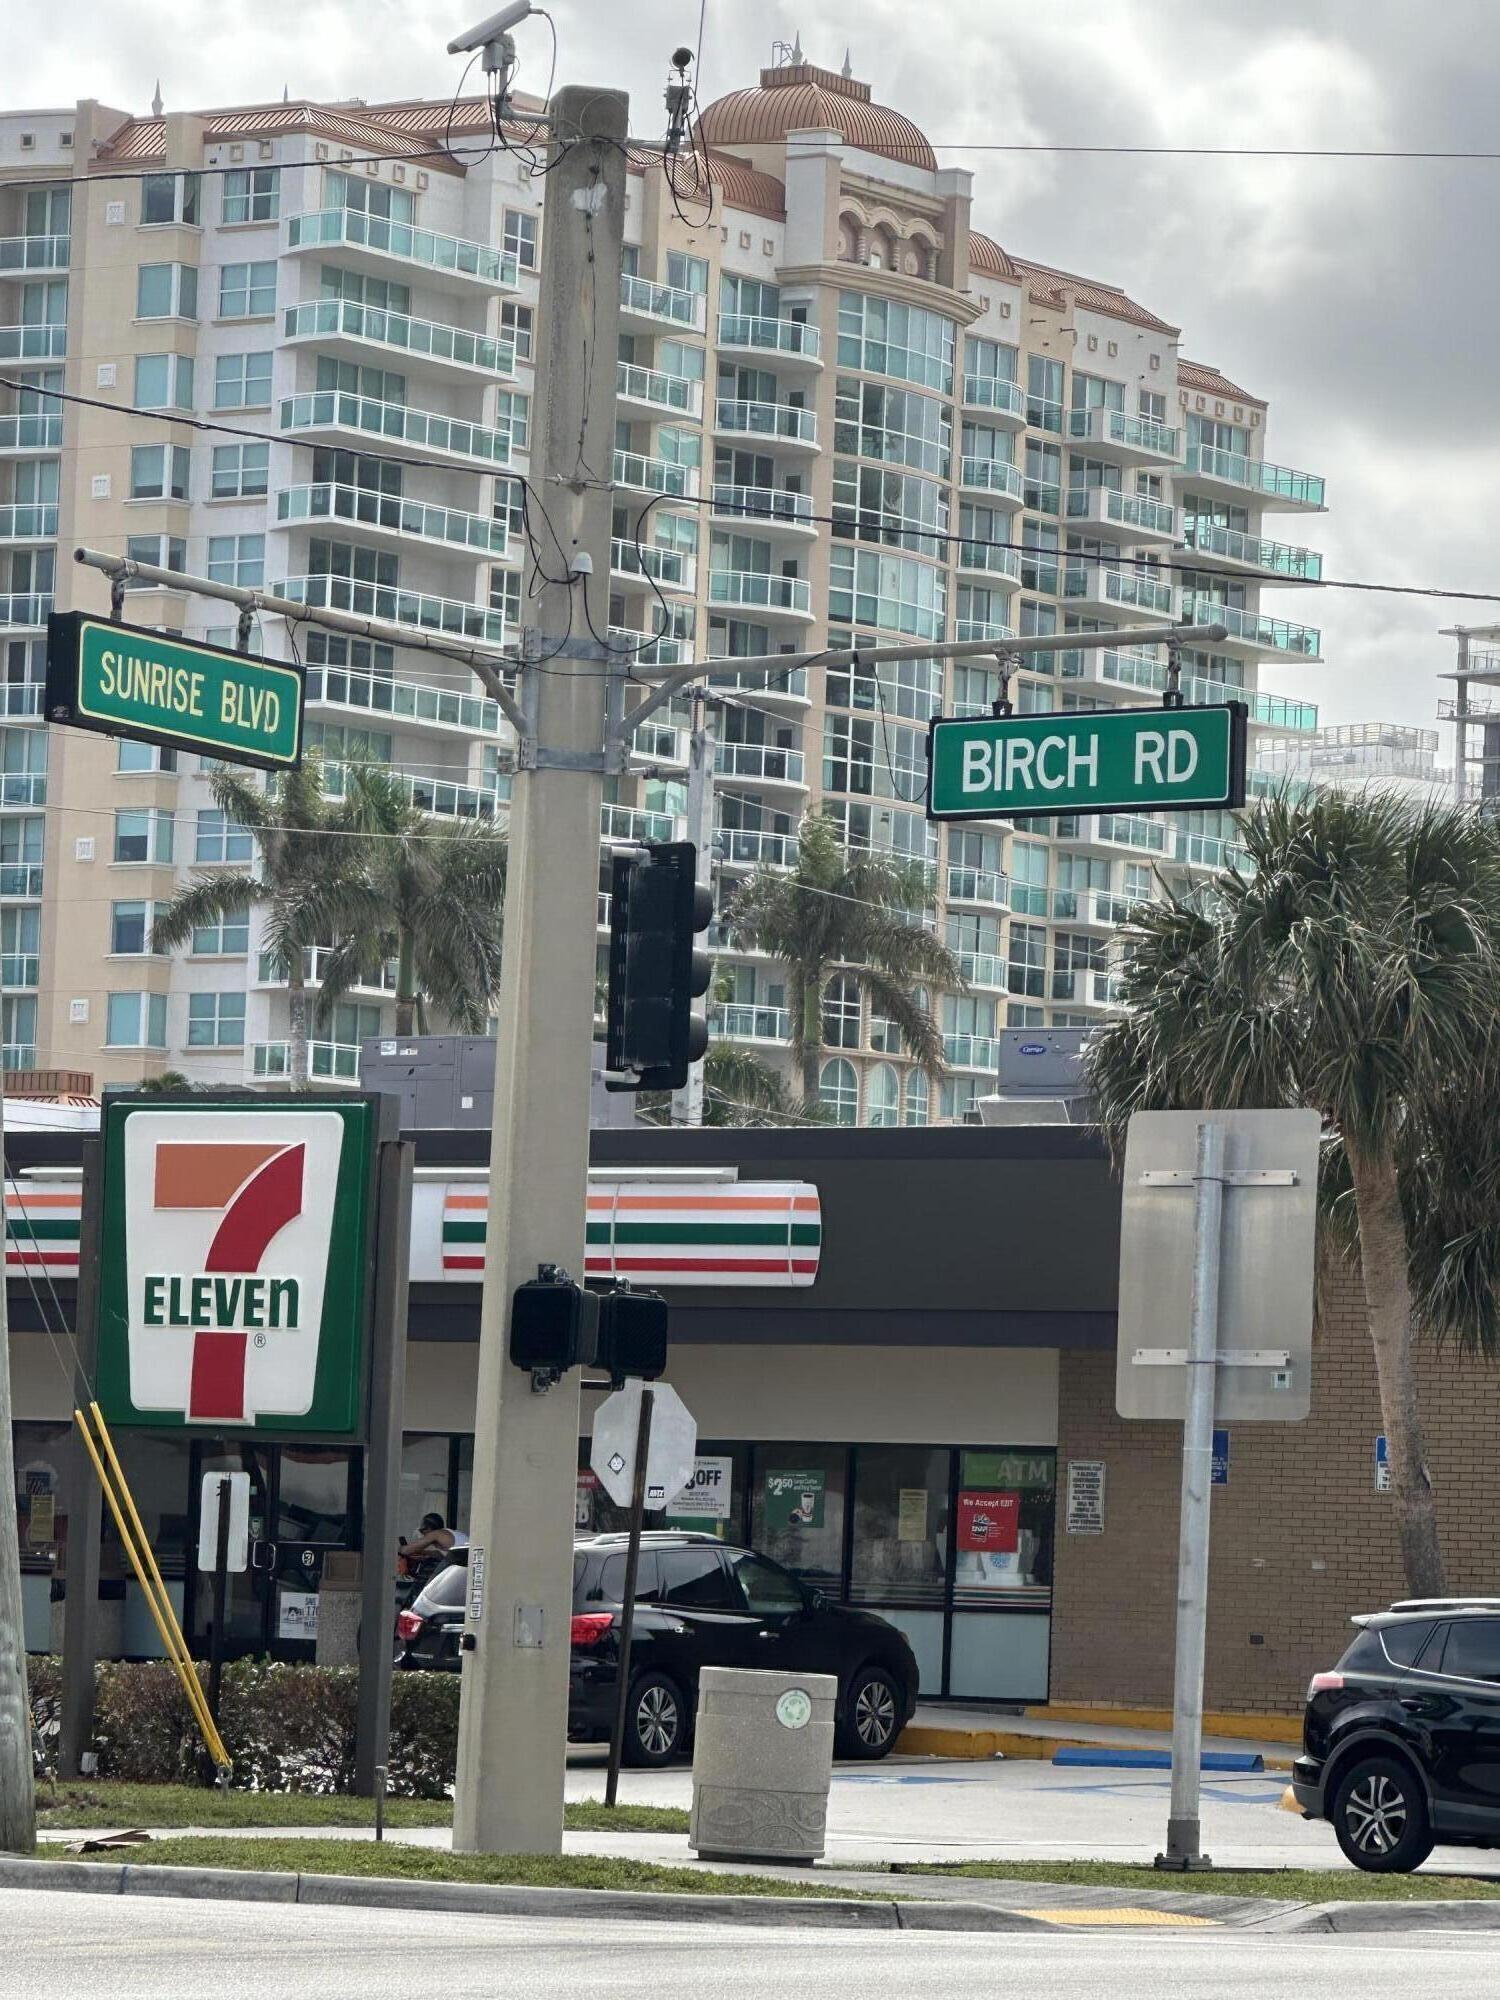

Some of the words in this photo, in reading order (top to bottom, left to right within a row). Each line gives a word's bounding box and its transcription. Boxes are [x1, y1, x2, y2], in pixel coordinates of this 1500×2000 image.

[100, 650, 205, 717] SUNRISE
[220, 680, 280, 734] BLVD
[962, 733, 1099, 793] BIRCH
[1134, 729, 1198, 785] RD
[997, 1459, 1048, 1482] ATM
[975, 1498, 999, 1508] Accept
